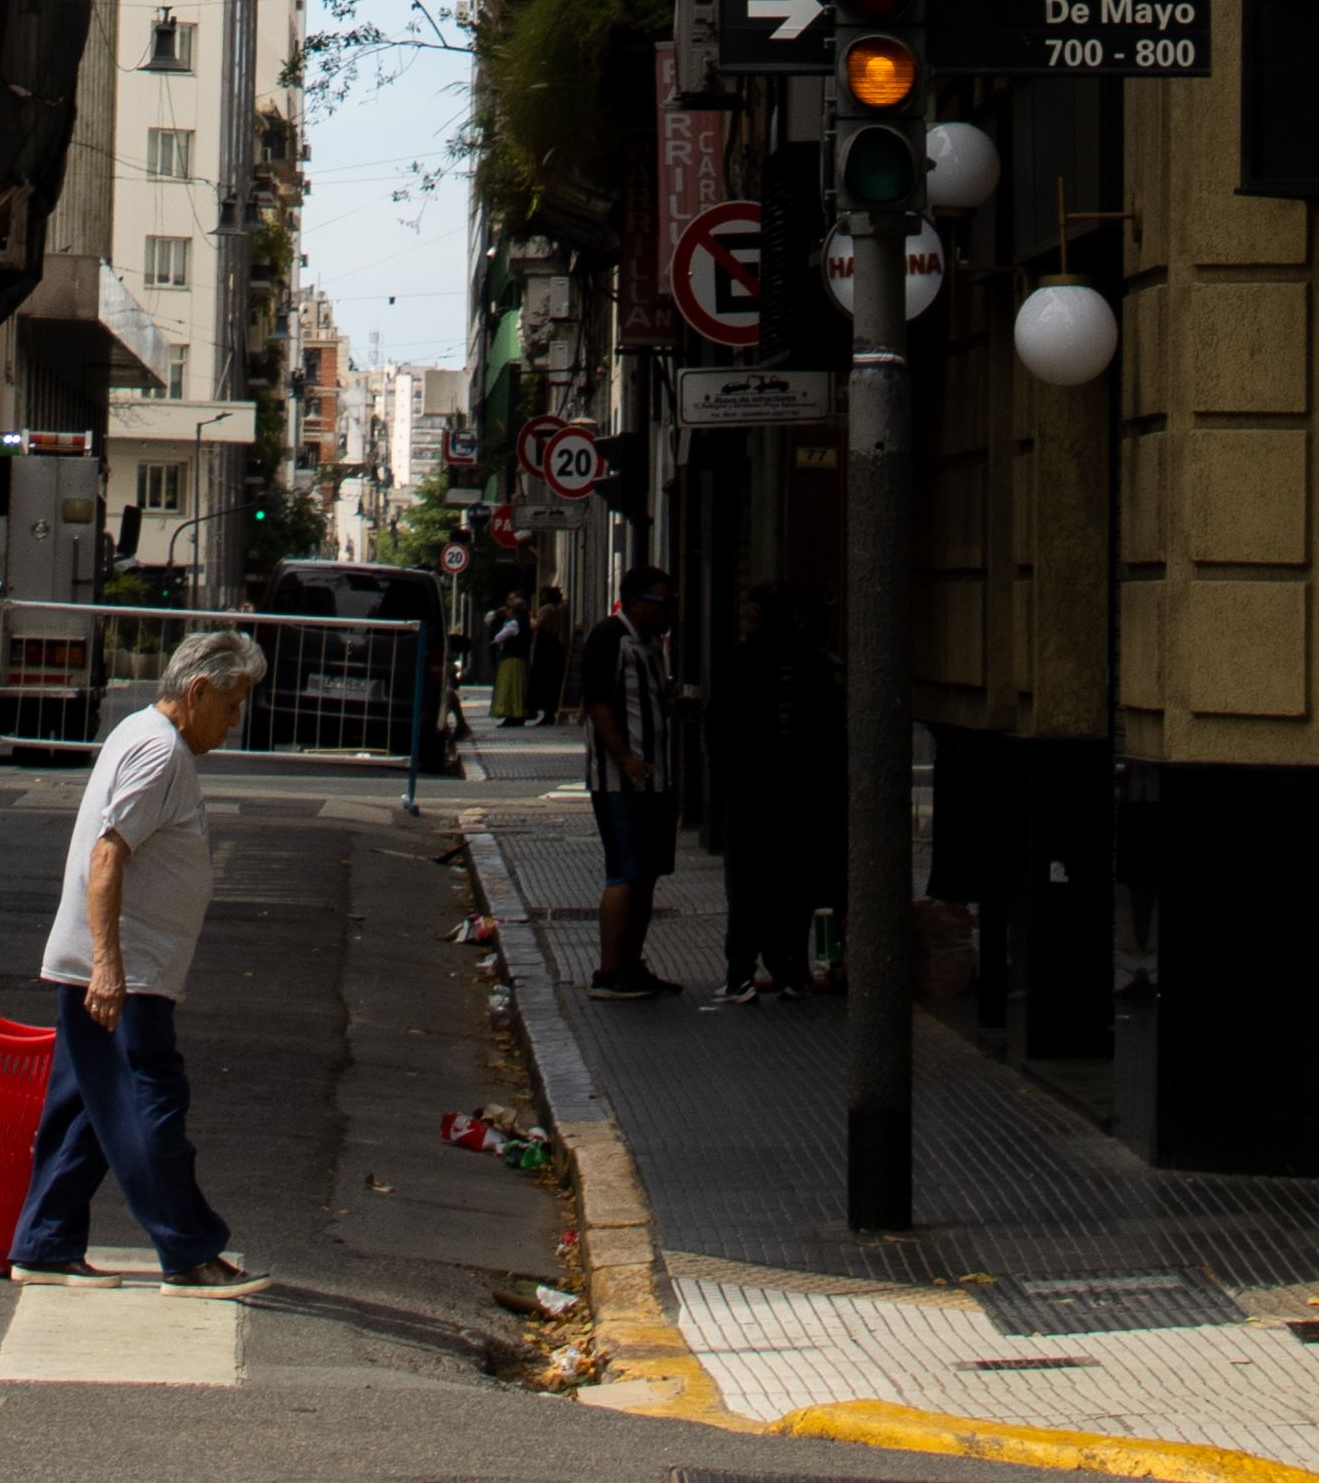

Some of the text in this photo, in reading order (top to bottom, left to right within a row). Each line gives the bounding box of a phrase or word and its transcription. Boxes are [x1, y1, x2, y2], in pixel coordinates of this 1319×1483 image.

[1045, 39, 1103, 67] 700
[1136, 39, 1195, 67] 800
[557, 449, 591, 477] 20
[493, 519, 513, 532] PA
[447, 552, 462, 564] 20
